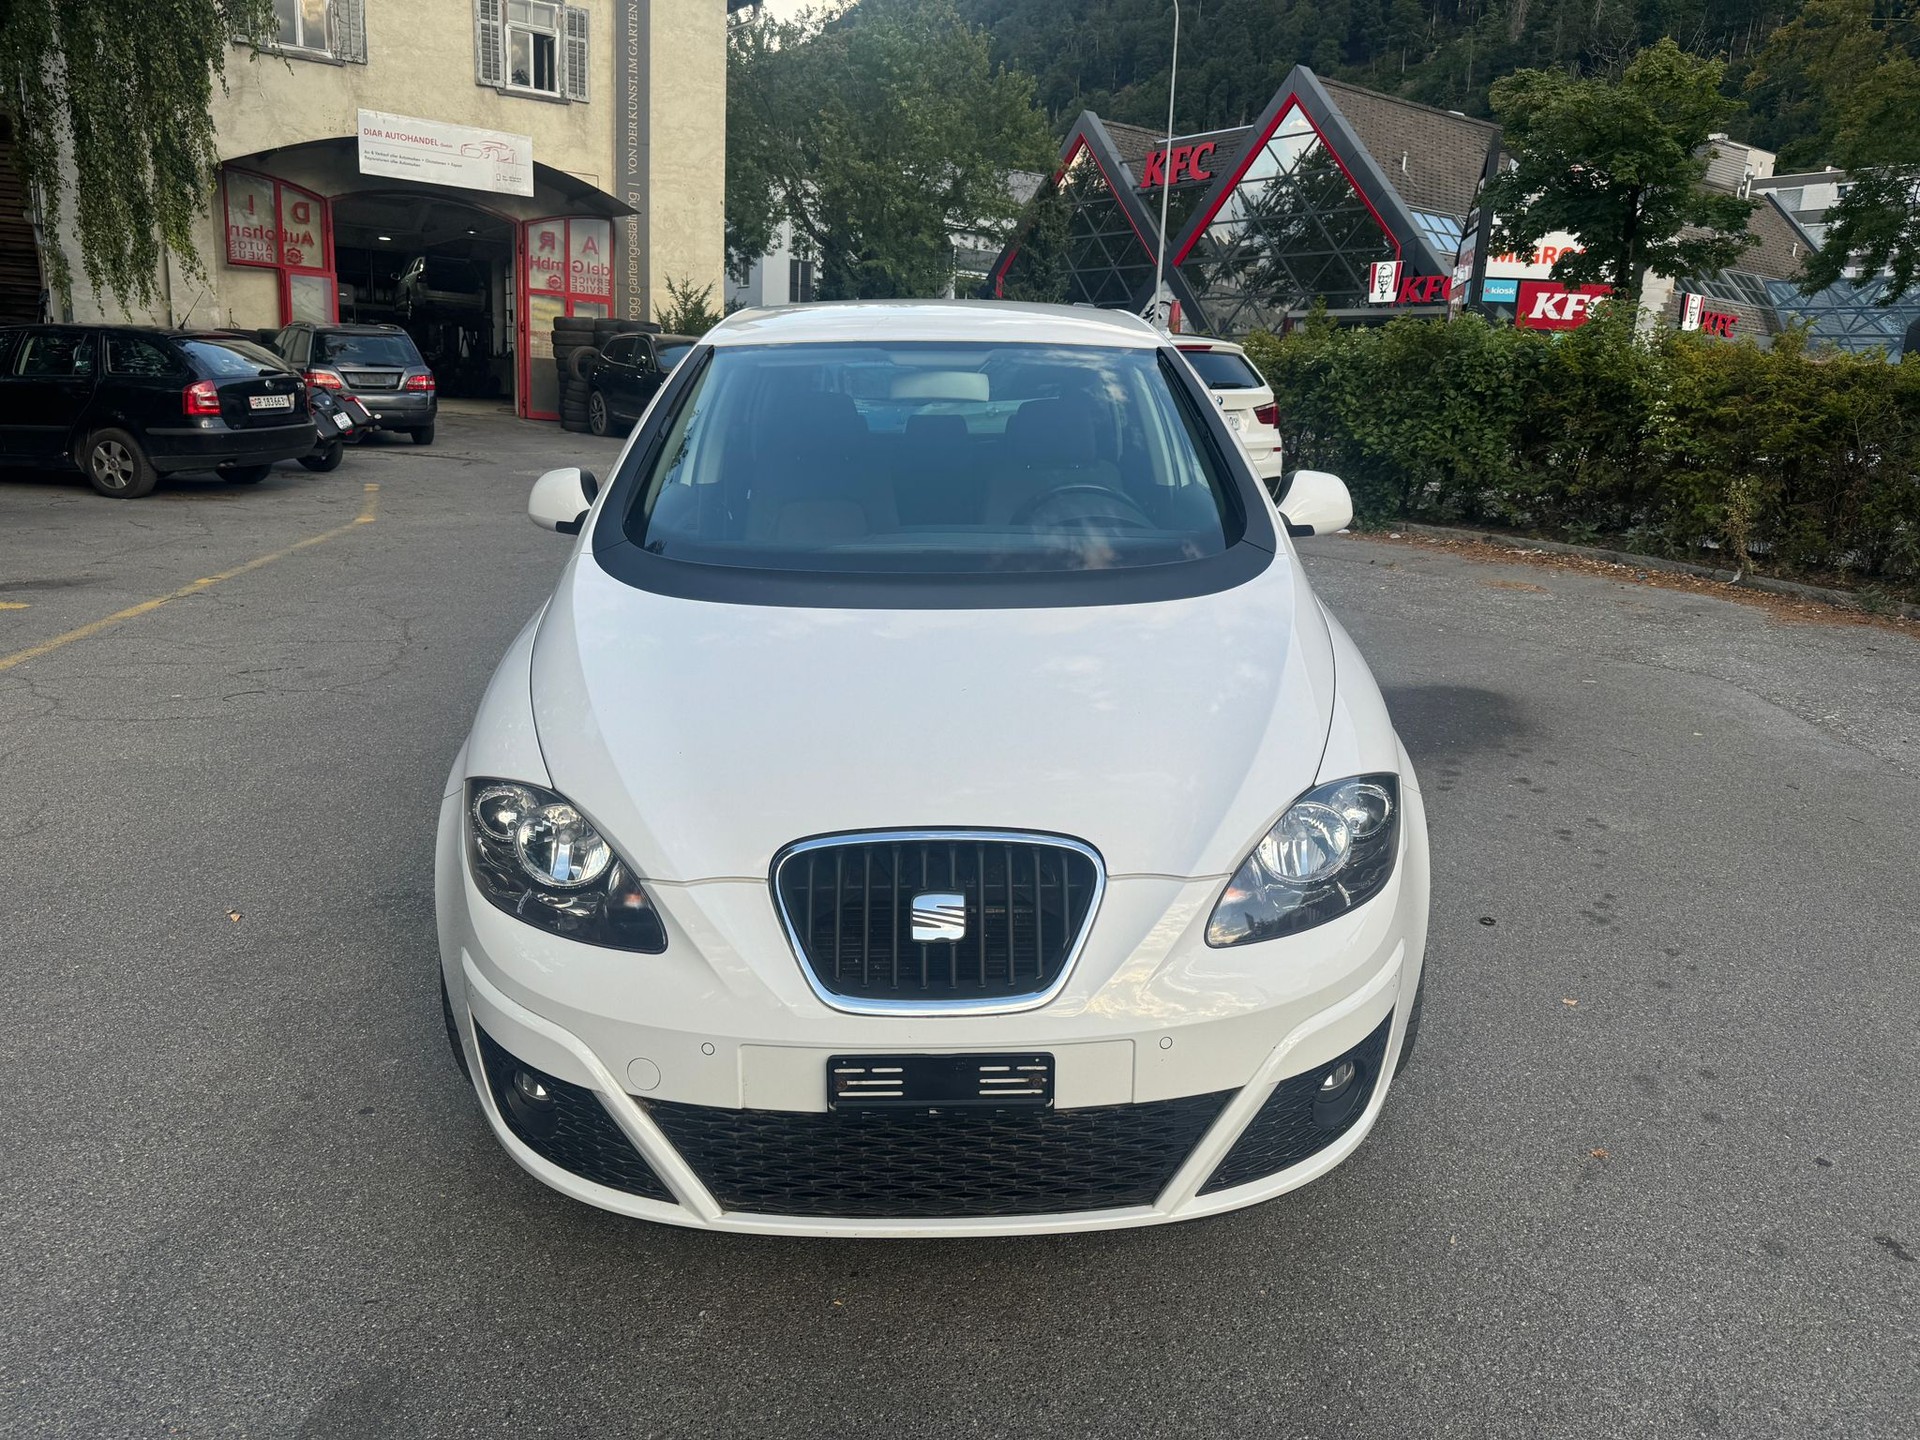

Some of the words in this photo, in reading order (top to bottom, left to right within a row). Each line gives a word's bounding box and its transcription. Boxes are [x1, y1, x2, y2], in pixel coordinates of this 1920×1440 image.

[628, 3, 638, 56] GARTEN
[628, 58, 638, 75] IM
[628, 76, 638, 121] KUNST,
[363, 128, 383, 137] DIAR
[384, 131, 439, 146] AUTOHANDEL
[628, 122, 638, 146] DER
[628, 149, 638, 175] VON
[1140, 141, 1216, 189] KFC
[626, 191, 641, 294] gartengestaltng
[1491, 286, 1515, 295] kiosk
[1702, 310, 1739, 339] KFC
